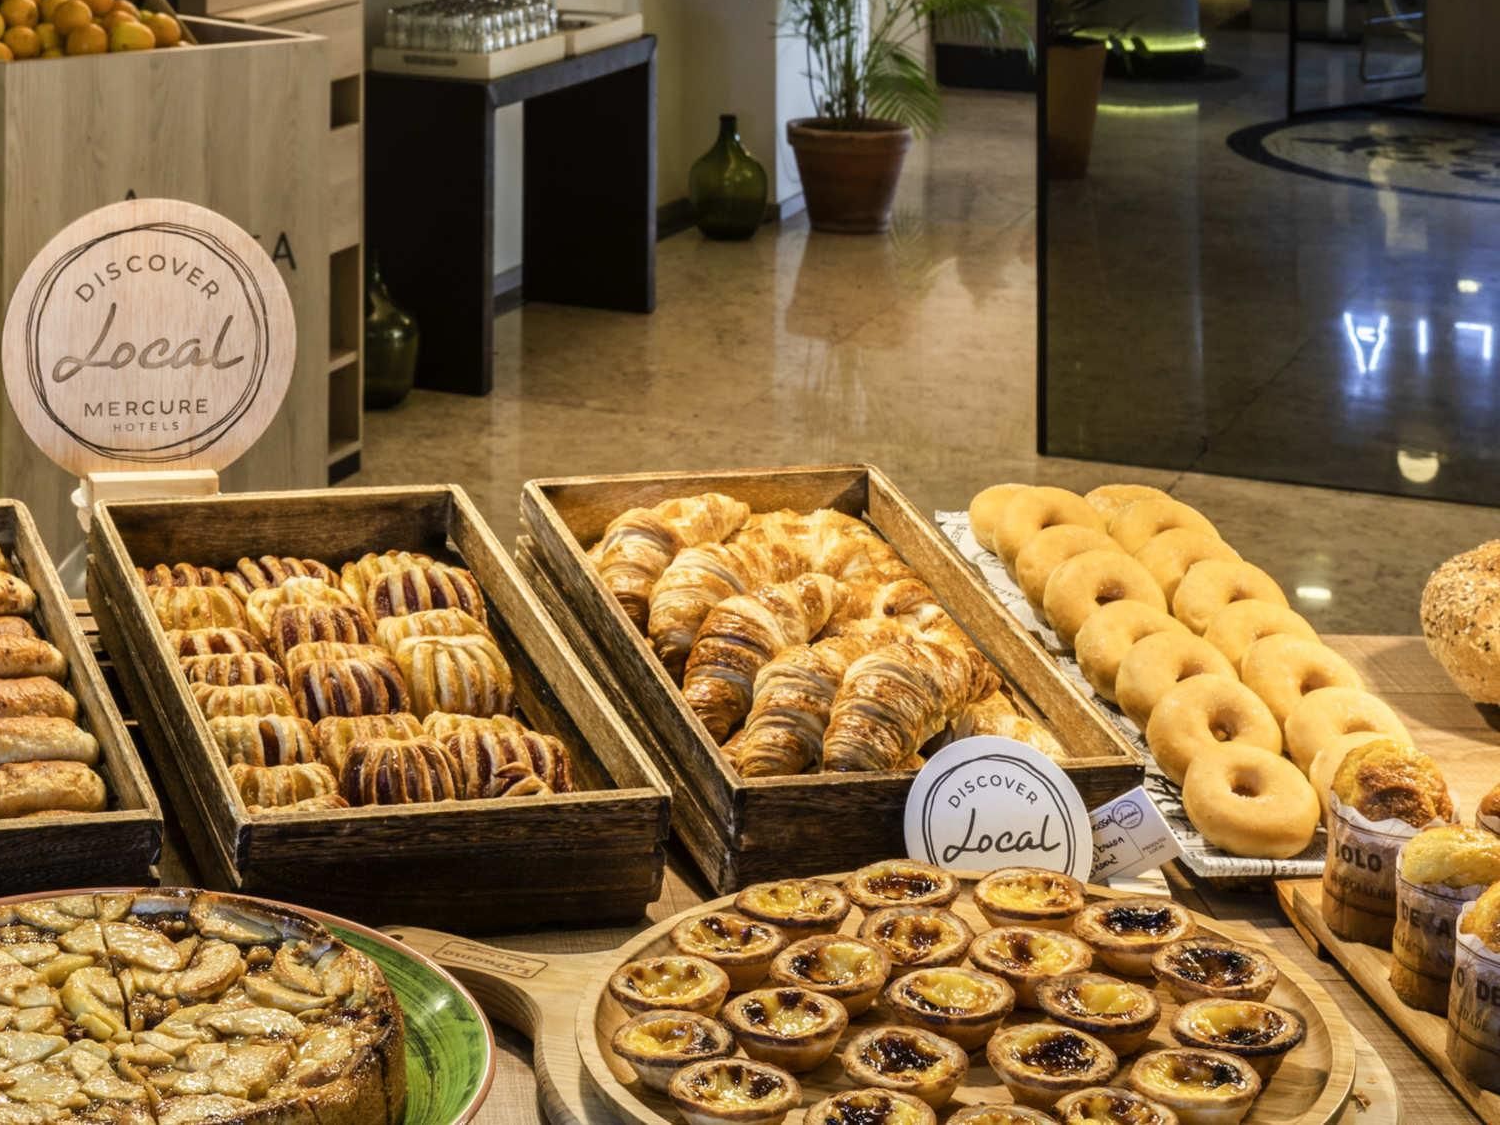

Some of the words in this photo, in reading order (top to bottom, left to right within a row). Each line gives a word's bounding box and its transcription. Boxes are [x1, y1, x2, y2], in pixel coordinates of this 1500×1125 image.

[74, 253, 221, 303] DISCOVER
[52, 302, 245, 383] Local
[83, 398, 209, 418] MERCURE
[112, 421, 180, 433] HOTELS
[947, 774, 1039, 809] DISCOVER
[943, 807, 1061, 863] Local
